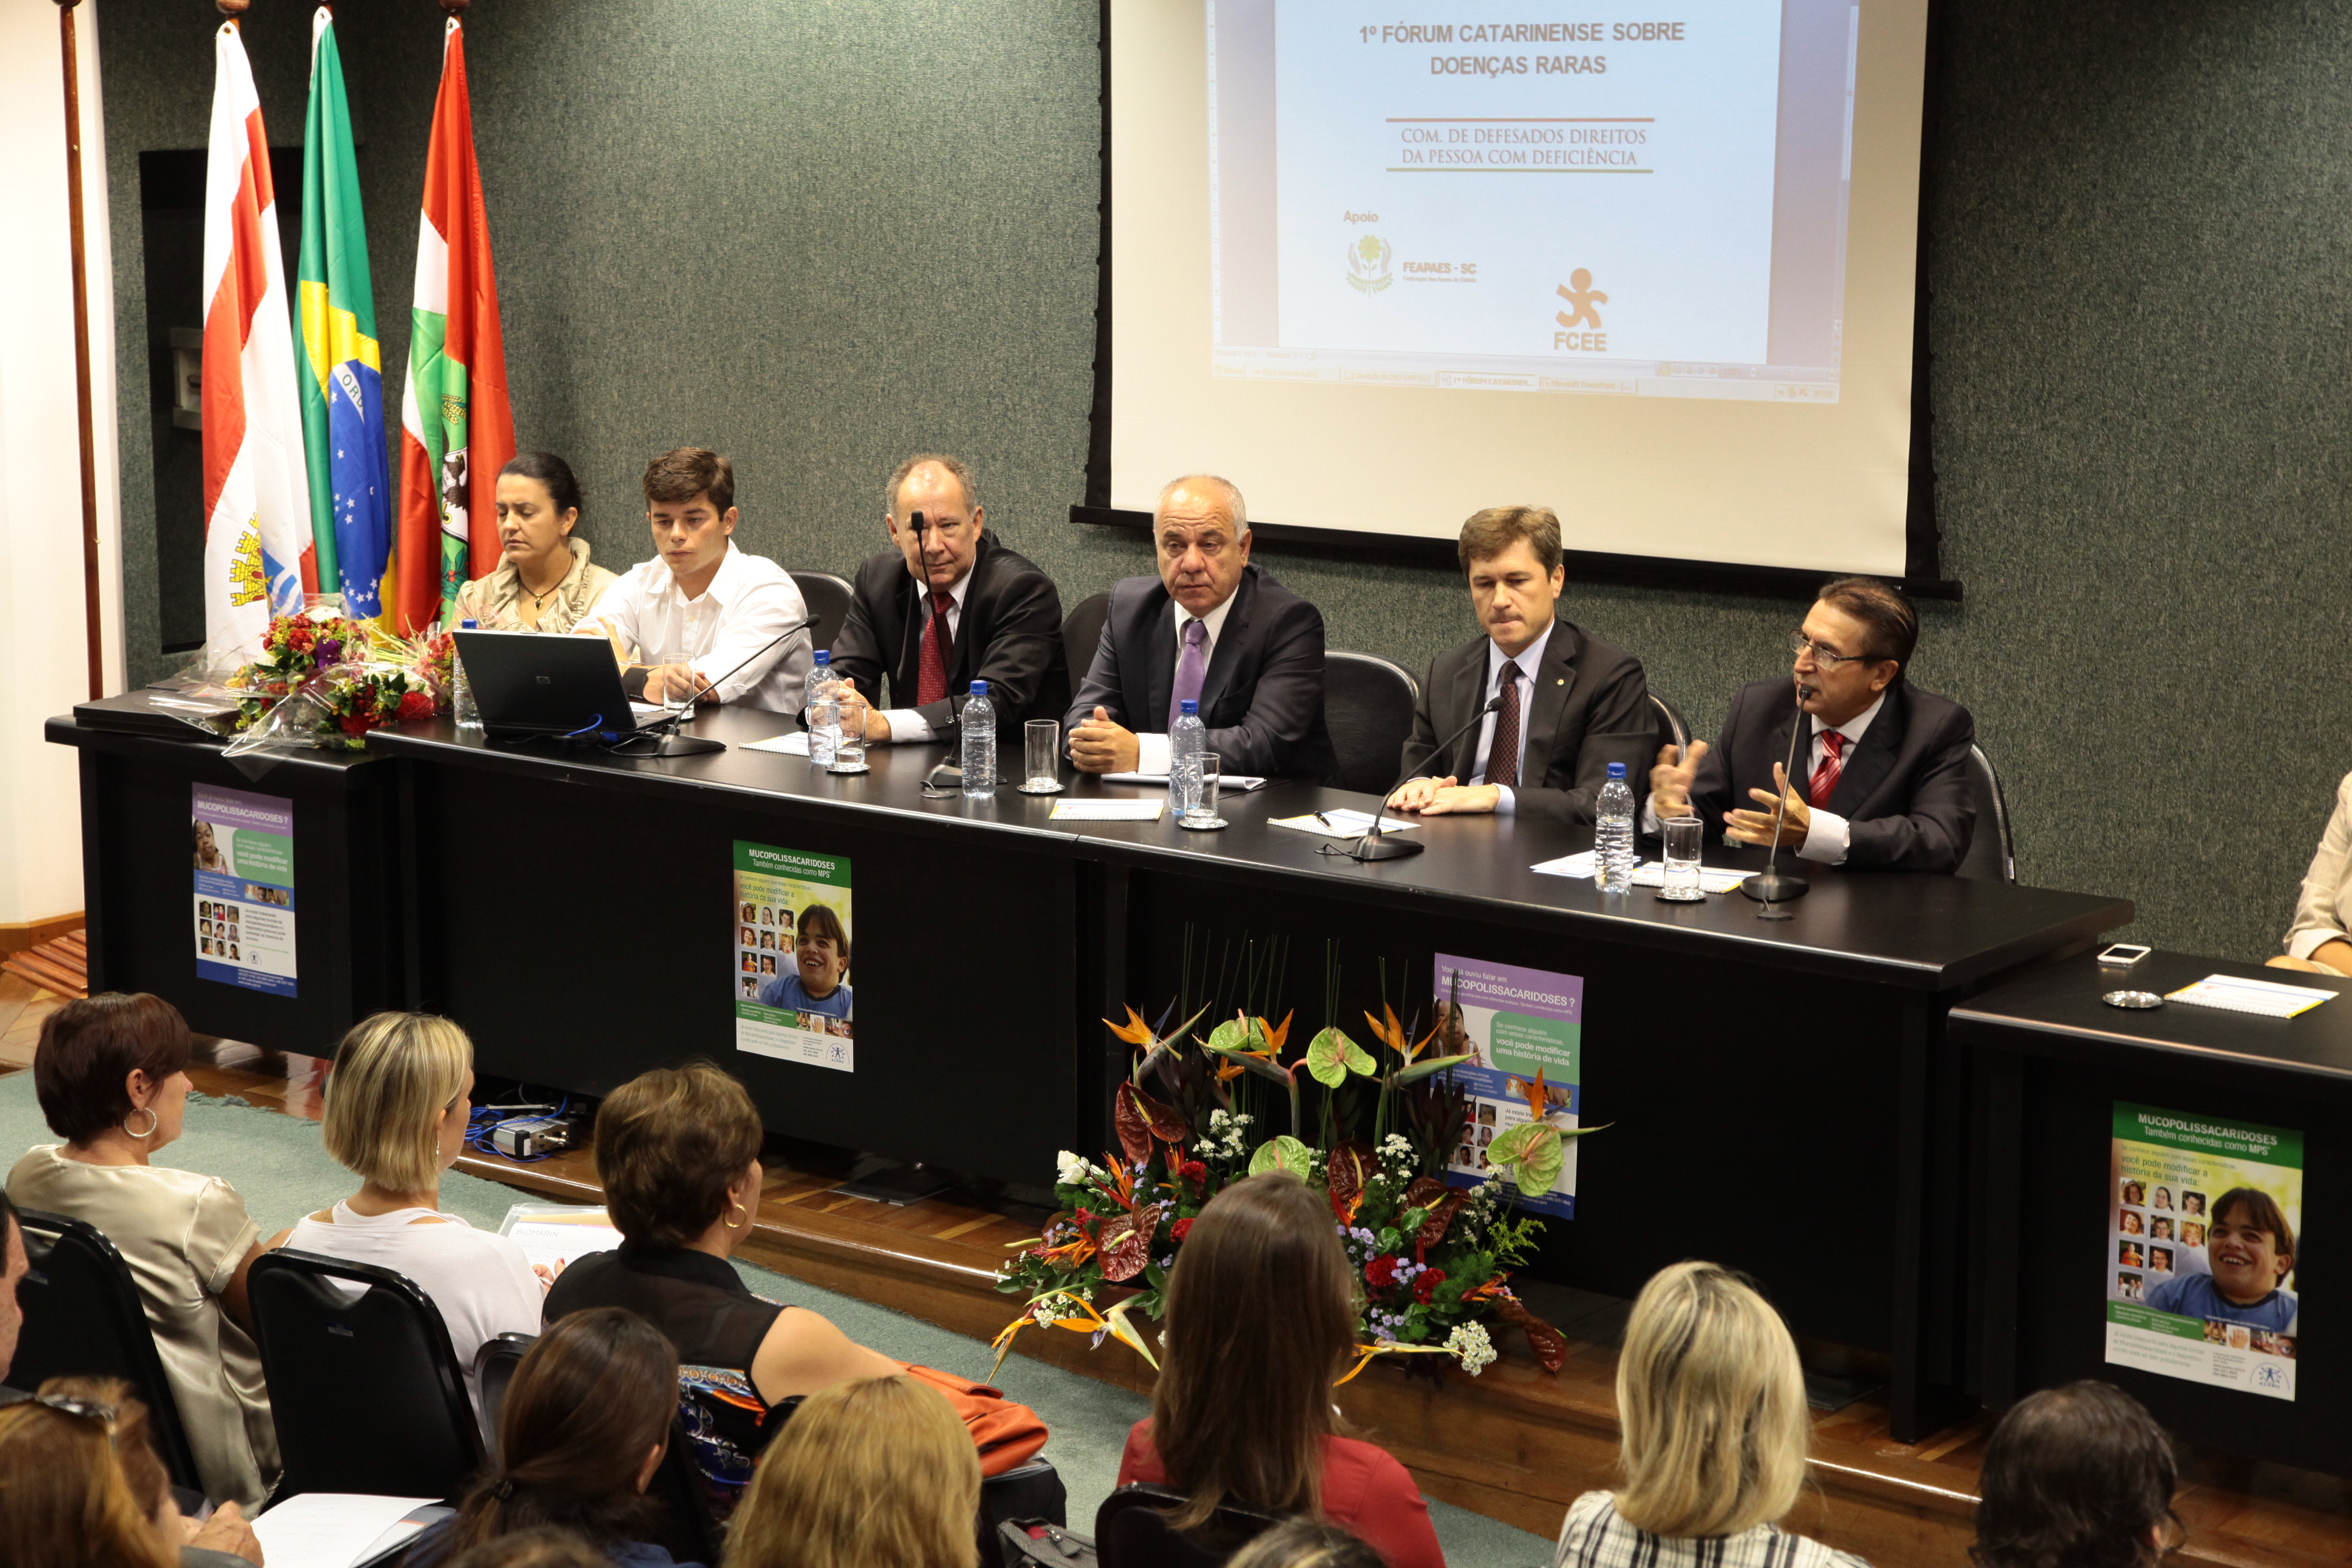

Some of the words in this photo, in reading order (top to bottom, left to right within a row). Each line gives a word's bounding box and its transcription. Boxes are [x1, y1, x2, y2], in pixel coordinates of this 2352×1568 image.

[1359, 24, 1377, 43] 1º
[1382, 21, 1452, 43] FÓRUM
[1459, 23, 1603, 43] CATARINENSE
[1612, 22, 1685, 41] SOBRE
[1431, 56, 1528, 78] DOENÇAS
[1536, 55, 1606, 75] RARAS
[1401, 129, 1442, 144] COM.
[1449, 129, 1468, 144] DE
[1474, 129, 1563, 144] DEFESADOS
[1570, 129, 1647, 145] DIREITOS
[1402, 149, 1423, 164] DA
[1428, 149, 1484, 165] PESSOA
[1488, 150, 1526, 165] COM
[1532, 146, 1637, 166] DEFICIÊNCIA
[1343, 210, 1378, 225] Apoio
[1403, 262, 1450, 274] FEAPAES
[1461, 263, 1477, 274] SC
[1554, 331, 1607, 352] FCEE
[197, 800, 283, 824] MUCOPOLISSACARIDOSES
[284, 816, 288, 824] ?
[749, 849, 835, 870] MUCOPOLISSACARIDOSES
[752, 858, 774, 869] Também
[774, 864, 802, 874] conhecidas
[803, 869, 817, 877] como
[740, 890, 759, 900] história
[766, 887, 789, 896] modificar
[1465, 970, 1482, 979] ouviu
[1483, 972, 1496, 981] falar
[1442, 975, 1567, 1007] MUCOPOLISSACARIDOSES
[1569, 997, 1575, 1008] ?
[1505, 1023, 1527, 1032] conhece
[1528, 1027, 1547, 1036] alguém
[1496, 1036, 1513, 1047] você
[1515, 1041, 1534, 1051] pode
[1535, 1044, 1571, 1058] modificar
[1496, 1047, 1512, 1056] uma
[1513, 1047, 1541, 1062] história
[1543, 1053, 1552, 1063] de
[1554, 1056, 1570, 1066] vida
[2138, 1113, 2278, 1146] MUCOPOLISSACARIDOSES
[2144, 1125, 2177, 1141] Também
[2178, 1133, 2222, 1149] conhecidas
[2225, 1141, 2247, 1153] como
[2121, 1155, 2140, 1164] você
[2142, 1159, 2161, 1168] pode
[2163, 1162, 2200, 1176] modificar
[2121, 1164, 2150, 1177] história
[2153, 1170, 2162, 1179] da
[2165, 1173, 2178, 1182] sua
